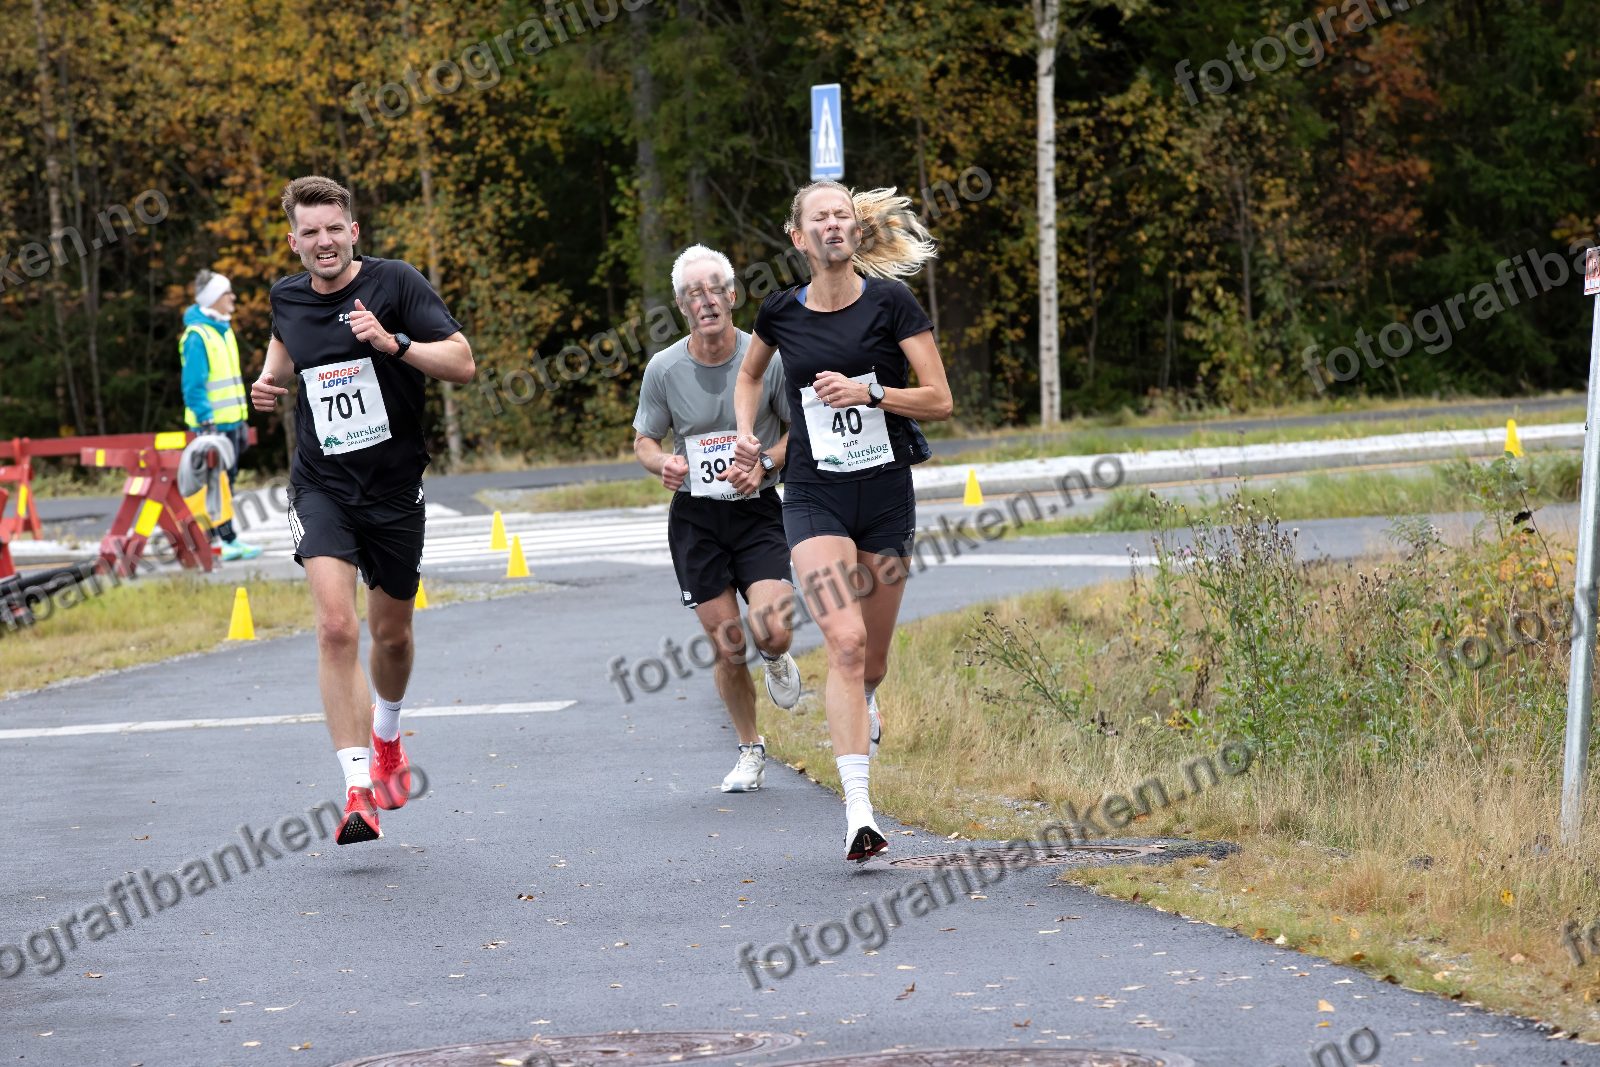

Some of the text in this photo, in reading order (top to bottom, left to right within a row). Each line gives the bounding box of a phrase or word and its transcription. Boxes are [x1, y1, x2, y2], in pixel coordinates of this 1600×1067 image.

[318, 366, 360, 381] NORGES
[323, 376, 354, 389] LØPET
[320, 389, 366, 422] 701
[832, 407, 863, 437] 40
[346, 424, 387, 440] Aurskog
[703, 443, 732, 453] LØPET
[847, 444, 888, 459] Aurskog
